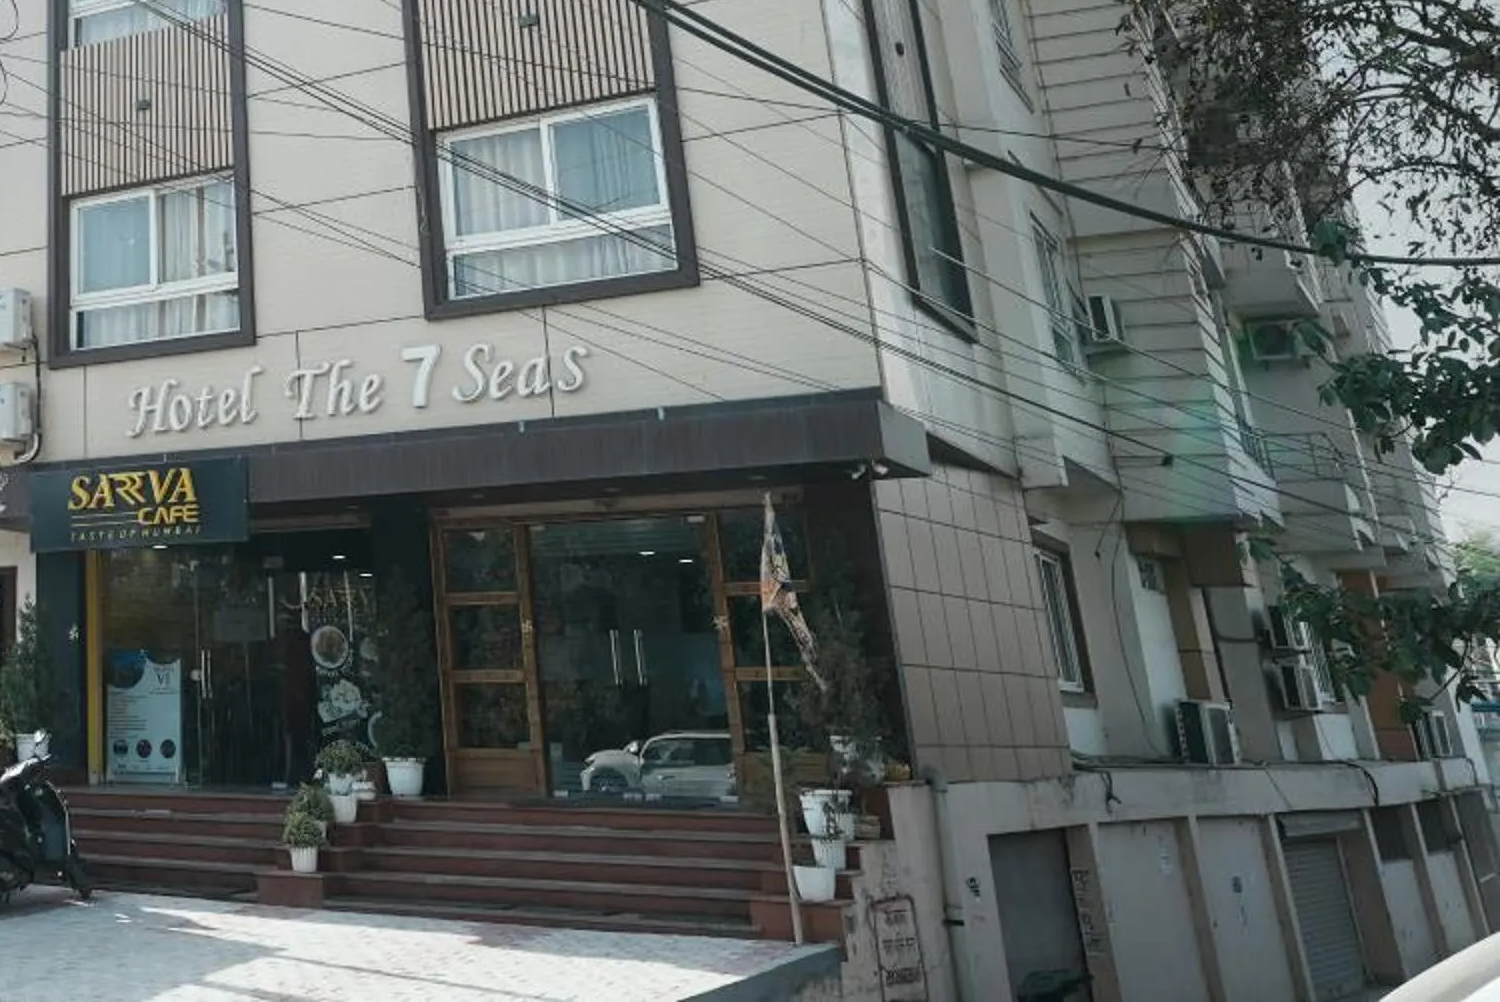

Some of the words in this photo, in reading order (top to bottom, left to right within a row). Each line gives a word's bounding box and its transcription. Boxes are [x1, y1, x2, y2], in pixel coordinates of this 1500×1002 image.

[125, 364, 264, 438] Hotel
[283, 358, 384, 422] The
[402, 343, 442, 409] 7
[452, 341, 590, 405] Seas
[137, 503, 200, 525] CAFE
[71, 527, 114, 543] TASTE
[119, 528, 137, 539] OF
[141, 524, 201, 538] MUMBAI
